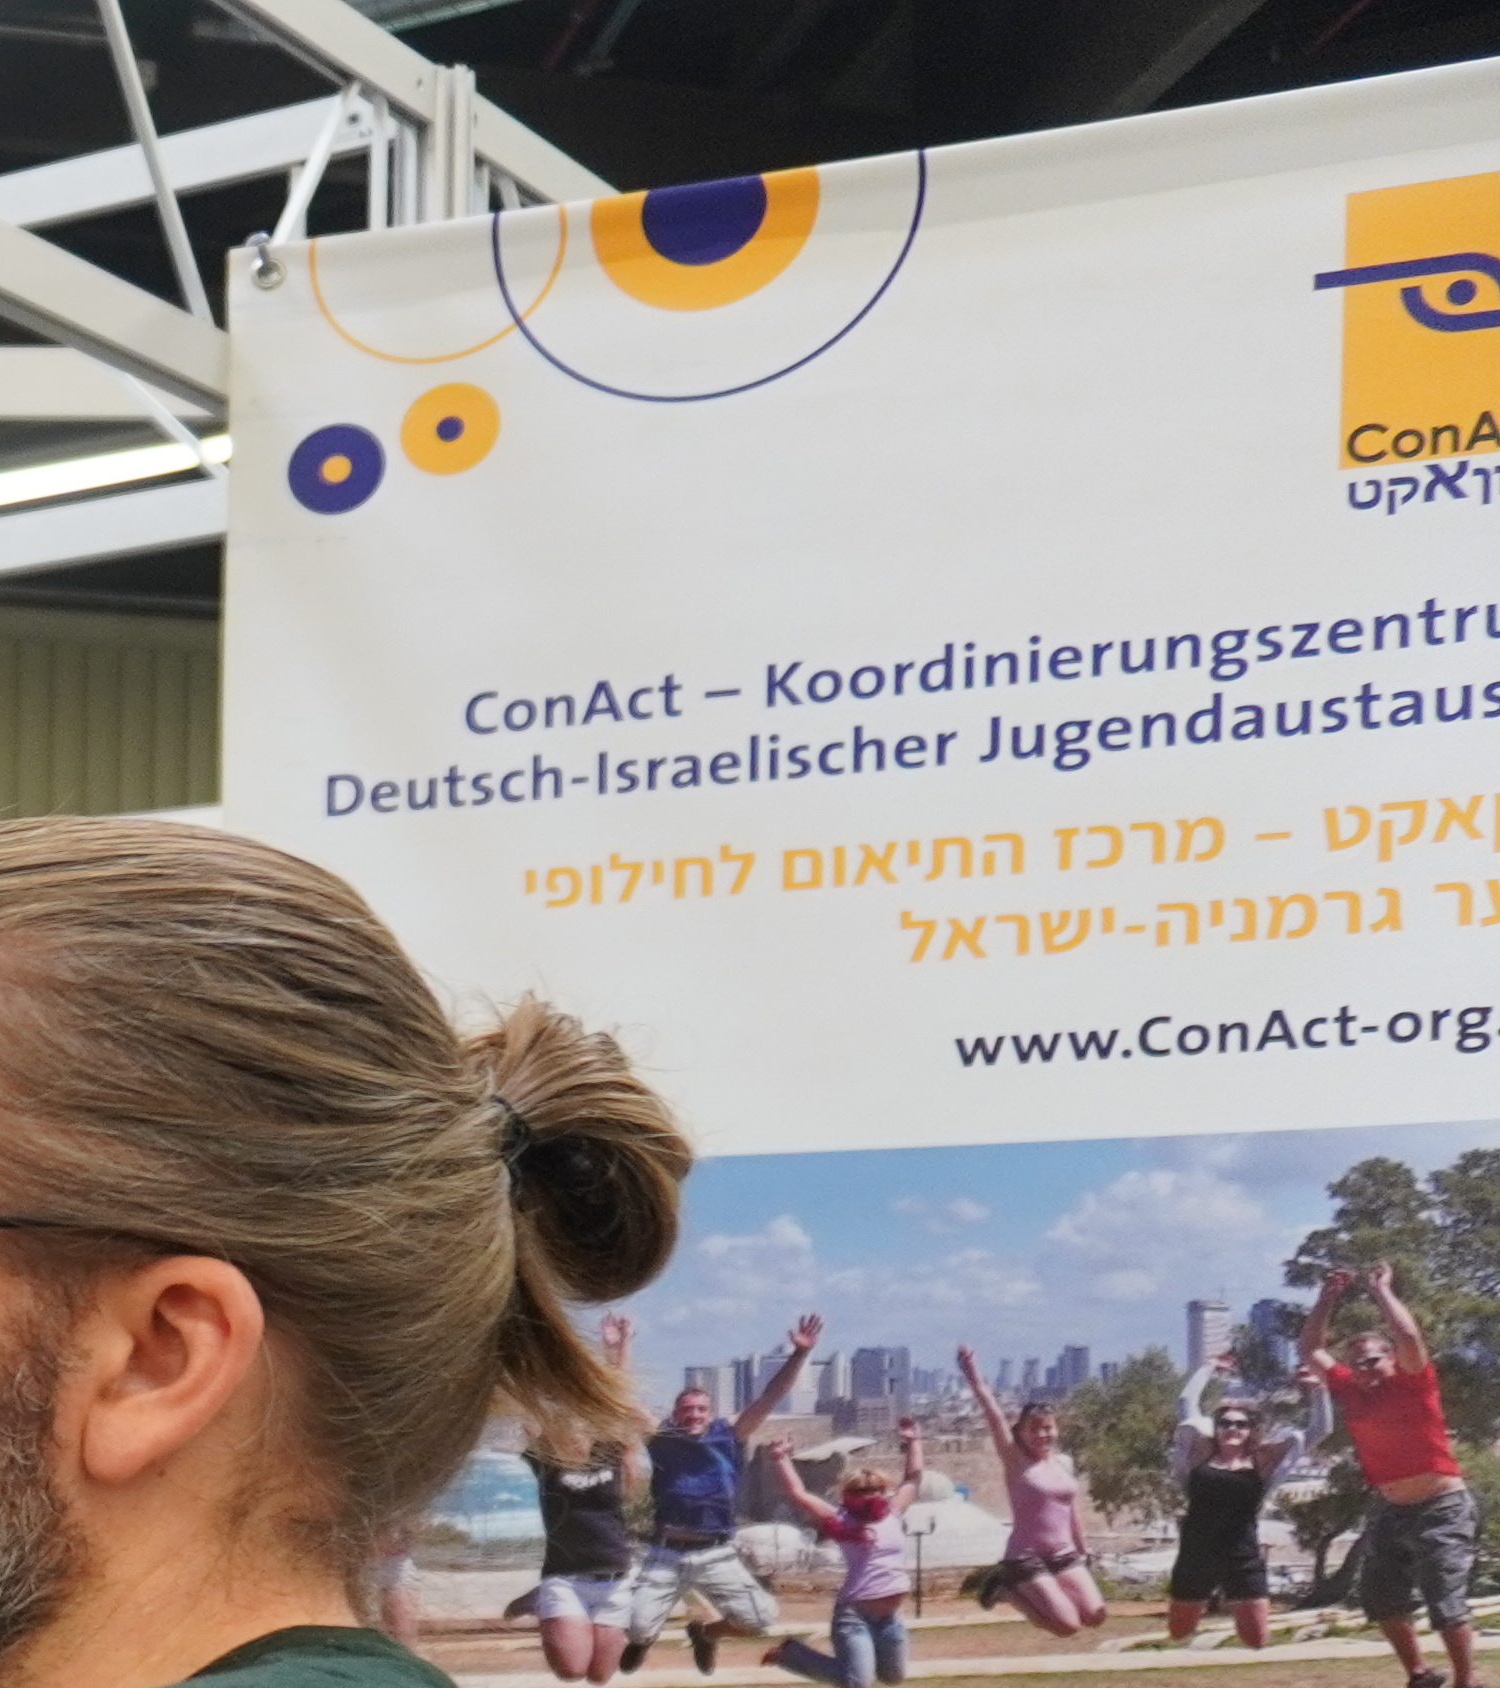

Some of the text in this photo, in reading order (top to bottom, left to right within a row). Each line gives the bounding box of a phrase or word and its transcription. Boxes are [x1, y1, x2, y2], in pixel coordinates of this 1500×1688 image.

[463, 669, 683, 739] ConAct
[323, 719, 957, 818] Deutsch-Israelischer
[523, 839, 754, 914] לחילופי
[780, 832, 1027, 893] התיאום
[1051, 813, 1227, 875] מרכז
